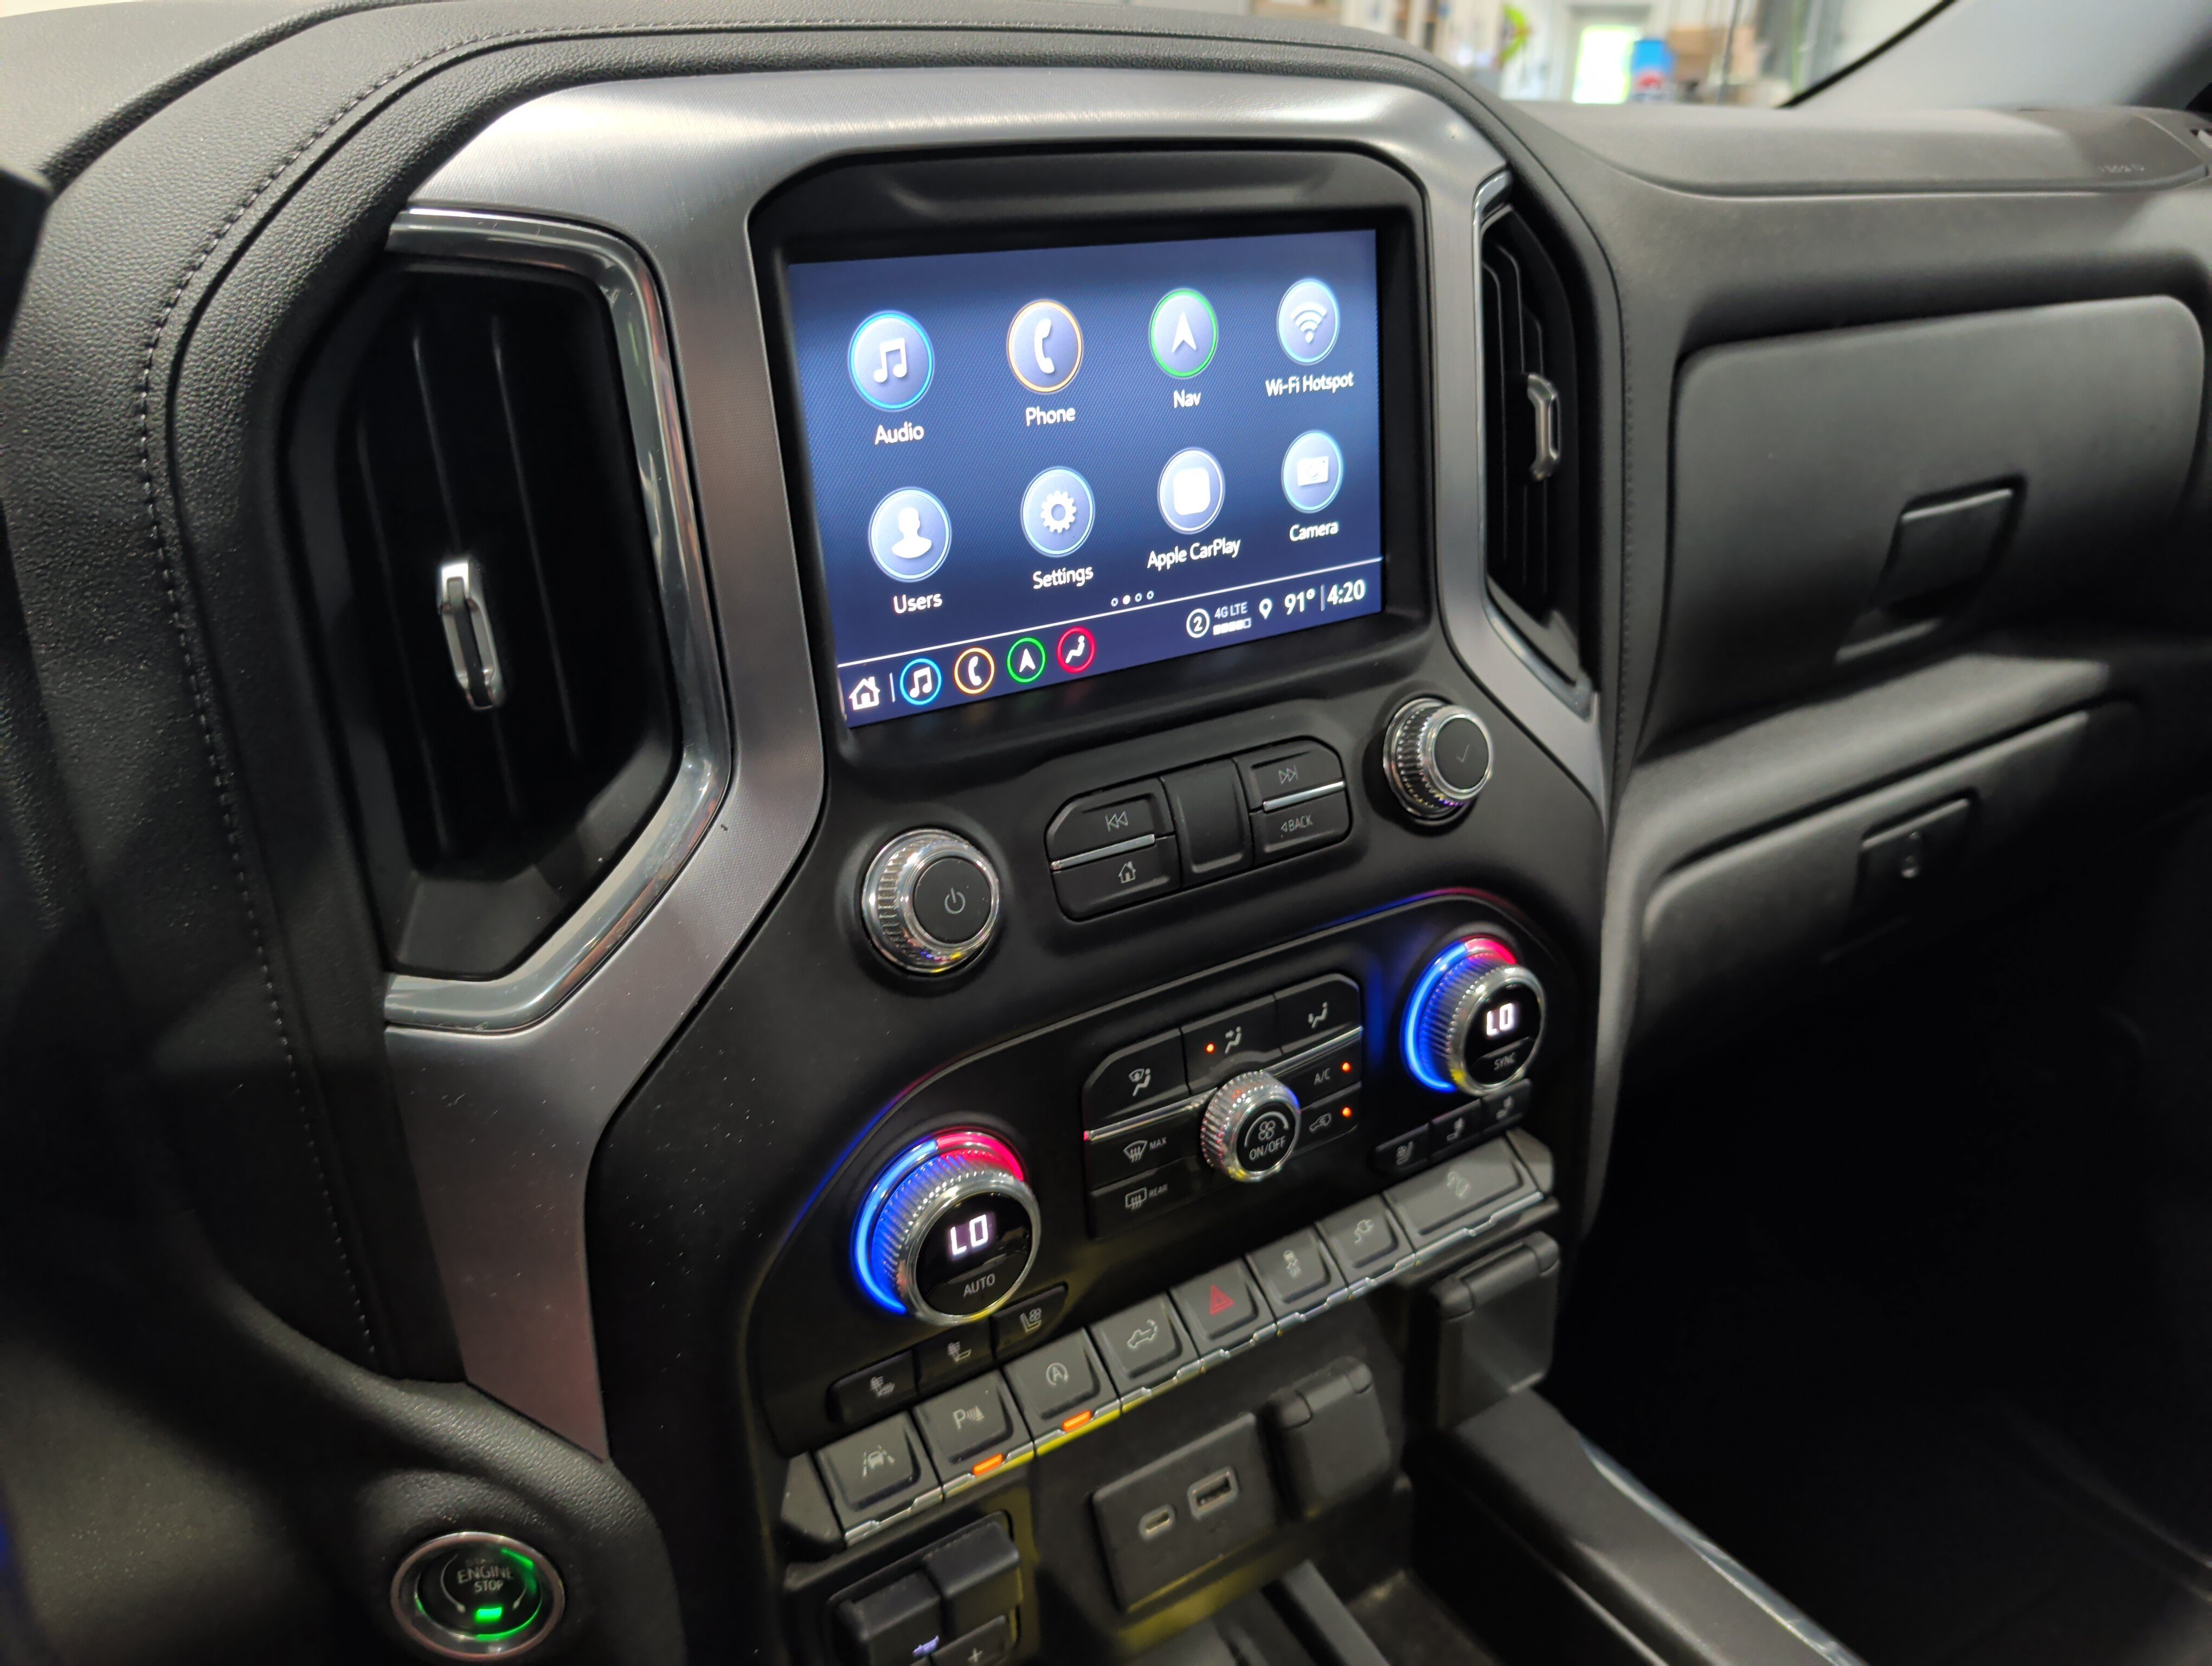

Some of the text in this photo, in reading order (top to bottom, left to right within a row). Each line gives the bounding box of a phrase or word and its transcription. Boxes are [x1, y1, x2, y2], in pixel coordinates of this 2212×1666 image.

[1264, 370, 1354, 396] Wi-Fi Hotspot
[1173, 389, 1202, 409] Nav
[1025, 404, 1076, 426] Phone
[874, 420, 925, 446] Audio
[1289, 520, 1339, 542] Camera
[1147, 536, 1242, 571] Apple CarPlay
[1032, 565, 1094, 589] Settings
[893, 592, 943, 614] Users
[1214, 606, 1229, 619] 4G
[1230, 602, 1249, 616] LTE
[1326, 579, 1366, 606] 4:20
[1288, 815, 1314, 831] BACK
[1314, 1068, 1331, 1085] A/C
[1149, 1137, 1167, 1151] MAX
[1249, 1137, 1285, 1161] ON/OFF
[1149, 1184, 1168, 1197] REAR
[963, 1273, 995, 1297] AUTO
[473, 1579, 504, 1594] STOP
